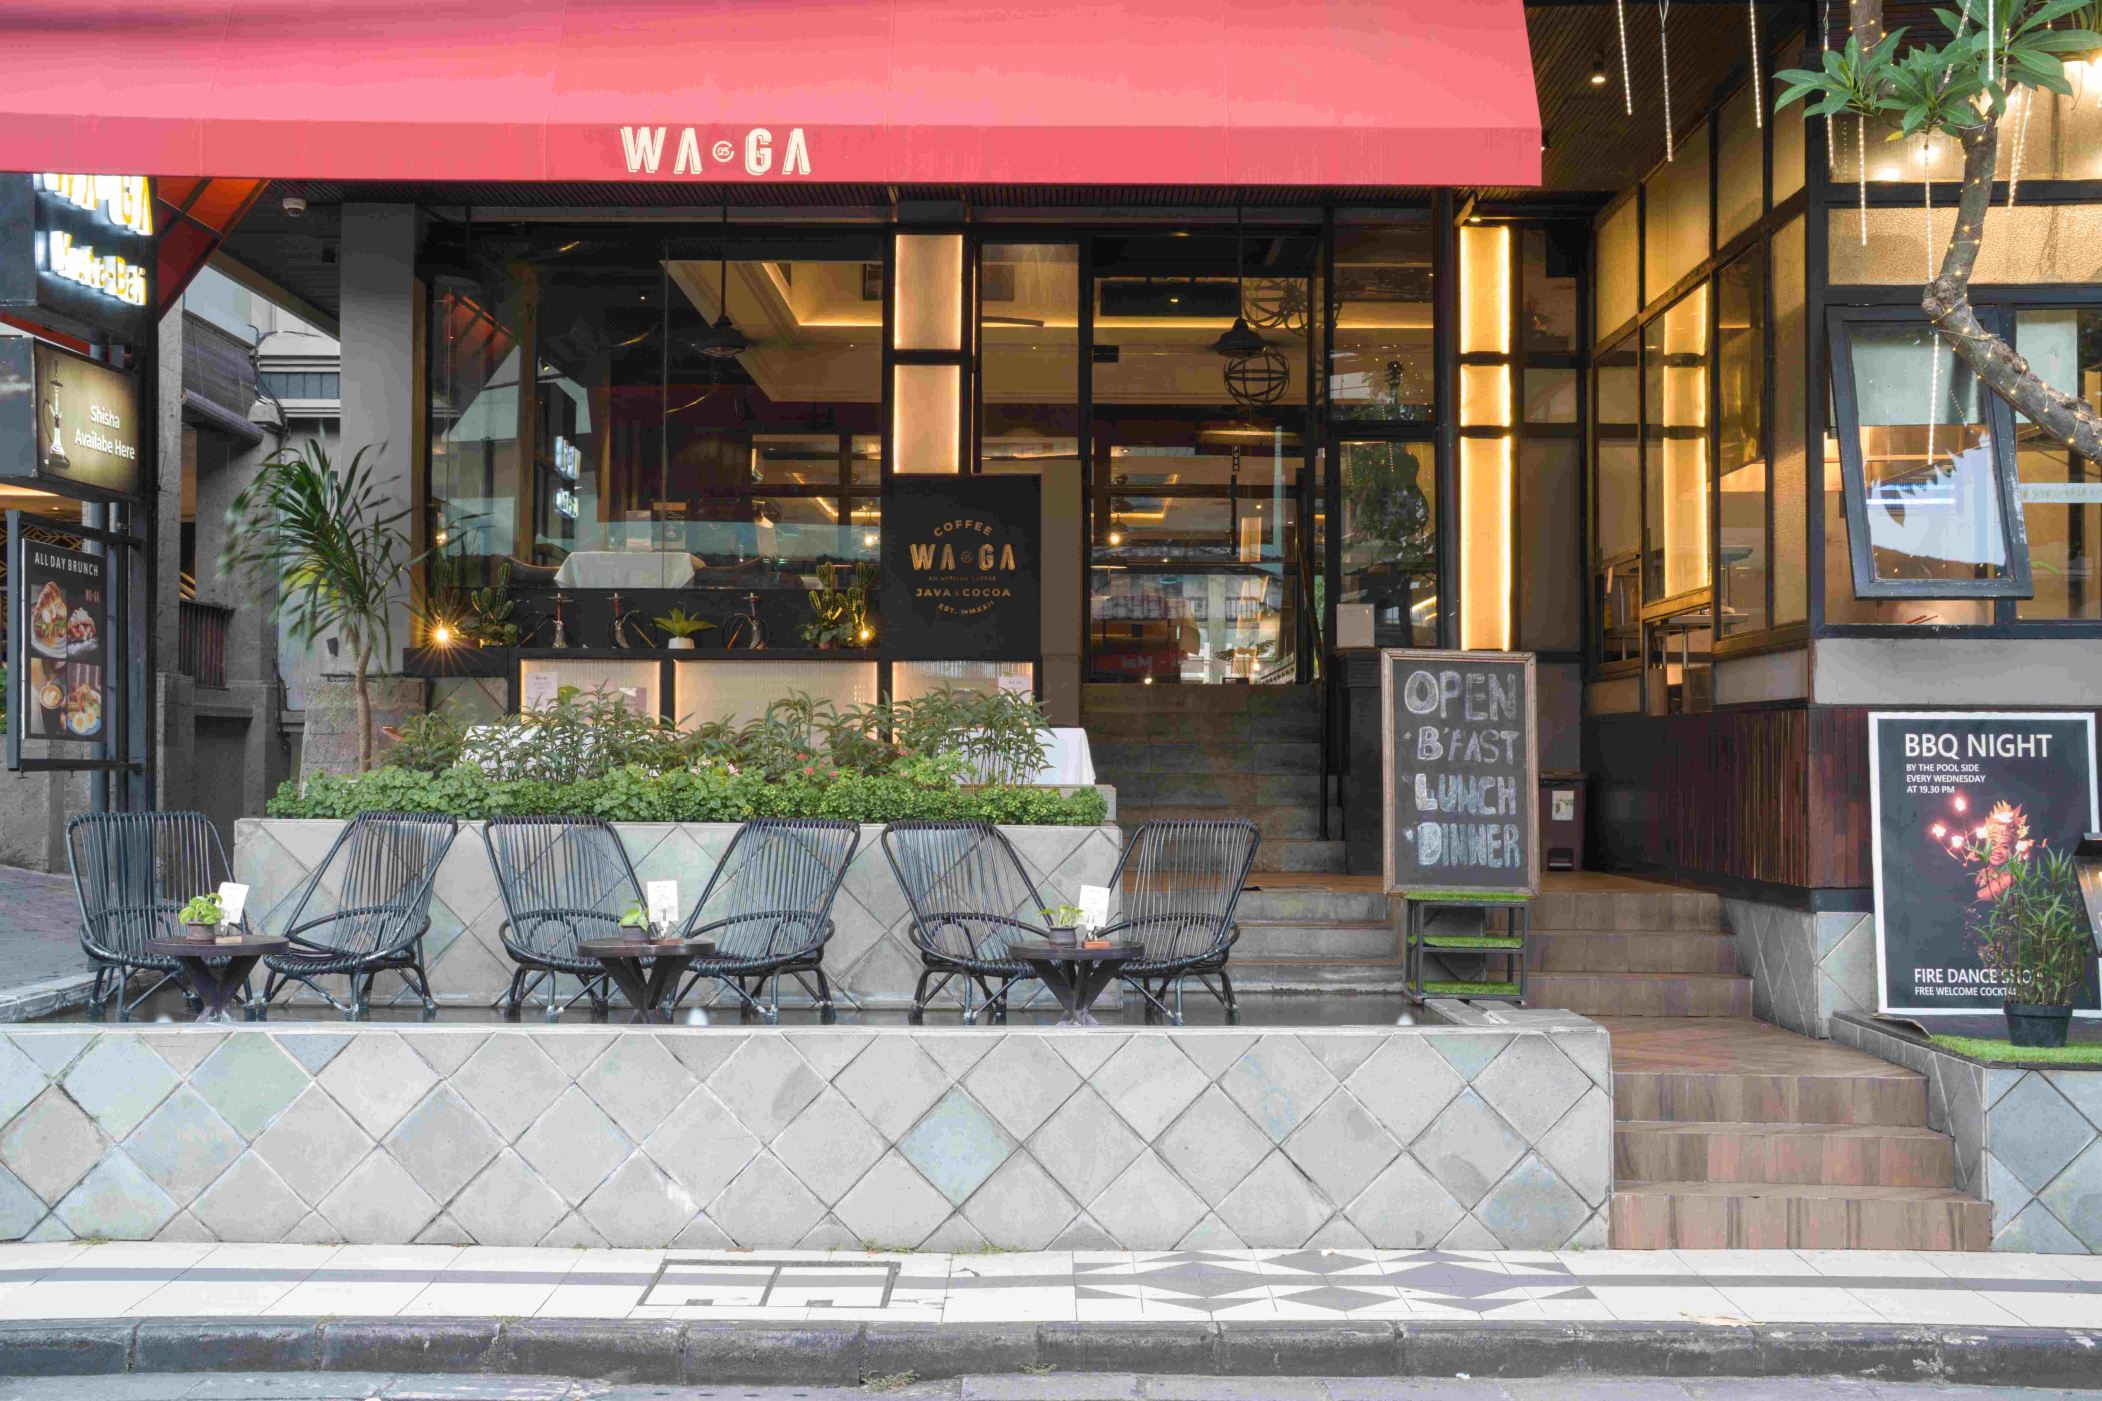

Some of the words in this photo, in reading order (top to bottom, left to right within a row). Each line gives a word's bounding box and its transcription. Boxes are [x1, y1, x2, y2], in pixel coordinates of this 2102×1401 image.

[90, 405, 120, 429] Shisha
[75, 428, 113, 454] Availabe
[115, 439, 135, 460] Here
[933, 519, 992, 536] COFFEE
[34, 552, 49, 567] ALL
[50, 555, 66, 570] DAY
[67, 559, 99, 577] BRUNCH
[915, 588, 951, 597] JAVA
[962, 588, 1011, 597] COCOA
[1404, 670, 1516, 721] OPEN
[1417, 725, 1519, 765] B'FAST
[1904, 733, 1960, 760] BBQ
[1967, 733, 2052, 758] NIGHT
[1906, 764, 1917, 772] BY
[1918, 764, 1934, 772] THE
[1937, 764, 1959, 772] POOL
[1961, 764, 1979, 772] SIDE
[1907, 775, 1931, 783] EVERY
[1933, 775, 1986, 783] WEDNESDAY
[1415, 773, 1516, 815] LUNCH
[1907, 785, 1917, 794] AT
[1919, 785, 1940, 794] 19.30
[1942, 785, 1955, 794] PM
[1417, 822, 1520, 868] DINNER
[1914, 968, 1943, 983] FIRE
[1948, 968, 1997, 984] DANCE
[1914, 986, 1934, 996] FREE
[1936, 986, 1978, 996] WELCOME
